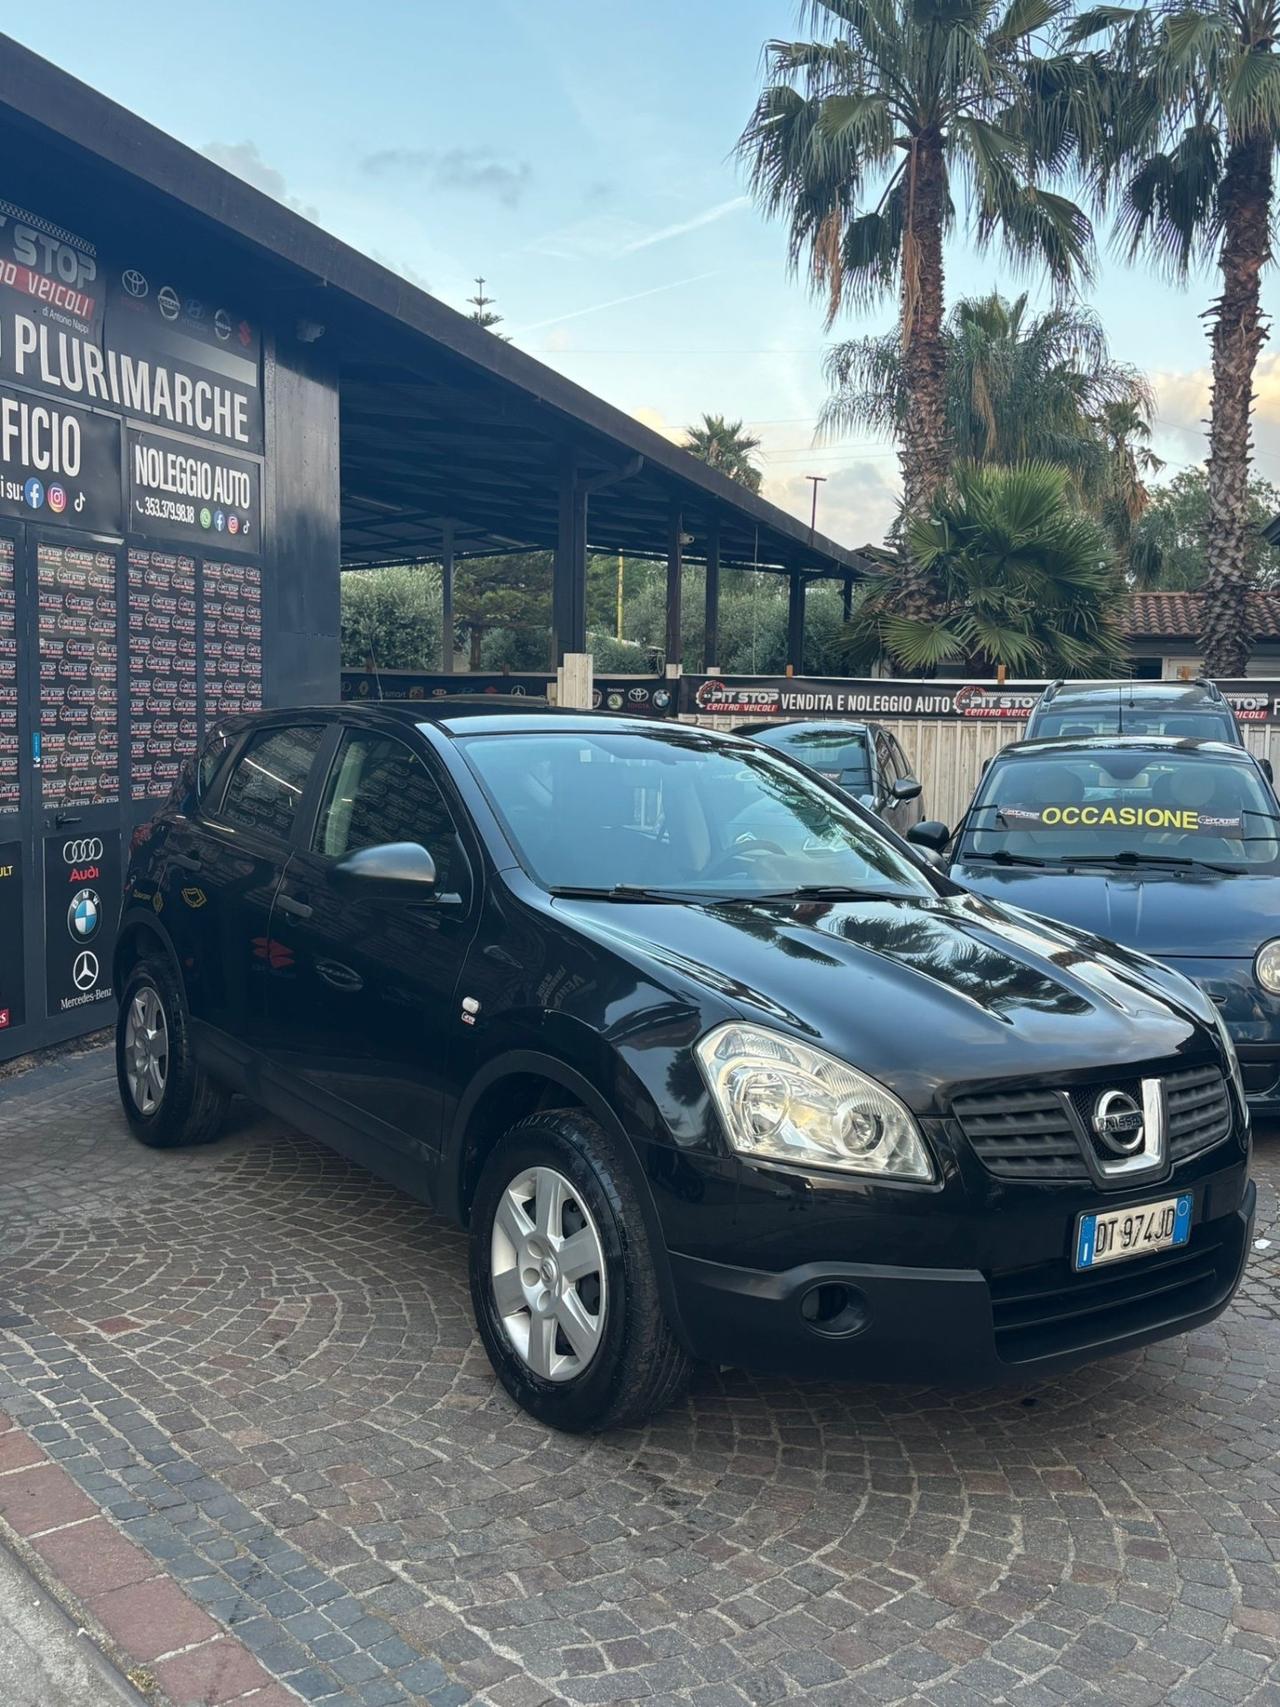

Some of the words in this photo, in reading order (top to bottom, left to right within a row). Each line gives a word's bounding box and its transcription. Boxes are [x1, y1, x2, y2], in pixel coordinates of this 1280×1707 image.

[13, 224, 96, 289] STOP
[15, 314, 249, 443] PLURIMARCHE
[136, 444, 212, 500] NOLEGGIO
[214, 466, 250, 509] AUTO
[711, 692, 736, 703] PIT
[738, 692, 780, 704] STOP
[782, 694, 834, 711] VENDITA
[836, 695, 844, 712] E
[848, 696, 911, 712] NOLEGGIO
[915, 696, 950, 713] AUTO
[970, 696, 998, 708] PIT
[1042, 806, 1200, 830] OCCASIONE
[70, 866, 99, 882] Audi
[72, 891, 99, 910] BMW
[60, 988, 112, 1010] Mercedes-Benz
[1096, 1216, 1118, 1254] DT
